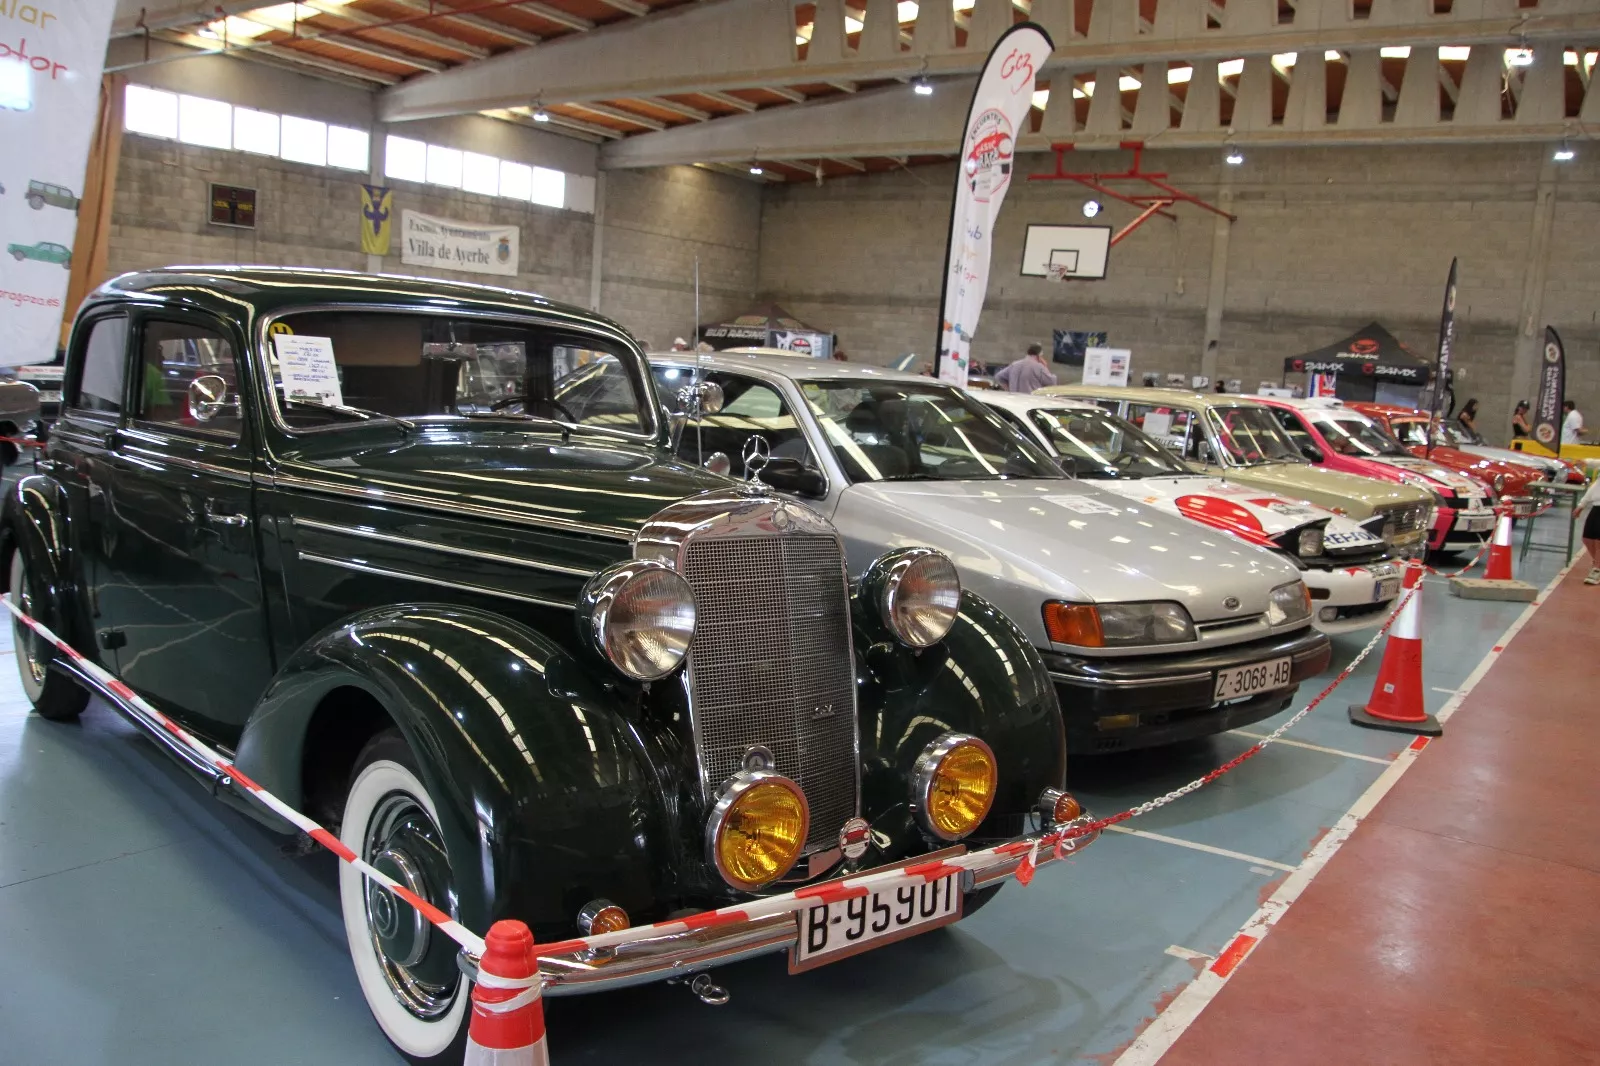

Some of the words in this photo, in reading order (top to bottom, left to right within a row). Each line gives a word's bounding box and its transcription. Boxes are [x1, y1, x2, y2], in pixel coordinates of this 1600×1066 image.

[408, 238, 436, 258] Villa
[438, 243, 452, 260] de
[454, 245, 491, 266] Ayerbe
[1304, 361, 1345, 372] 24MX
[1375, 365, 1417, 378] 24MX
[807, 874, 952, 953] B-95901
